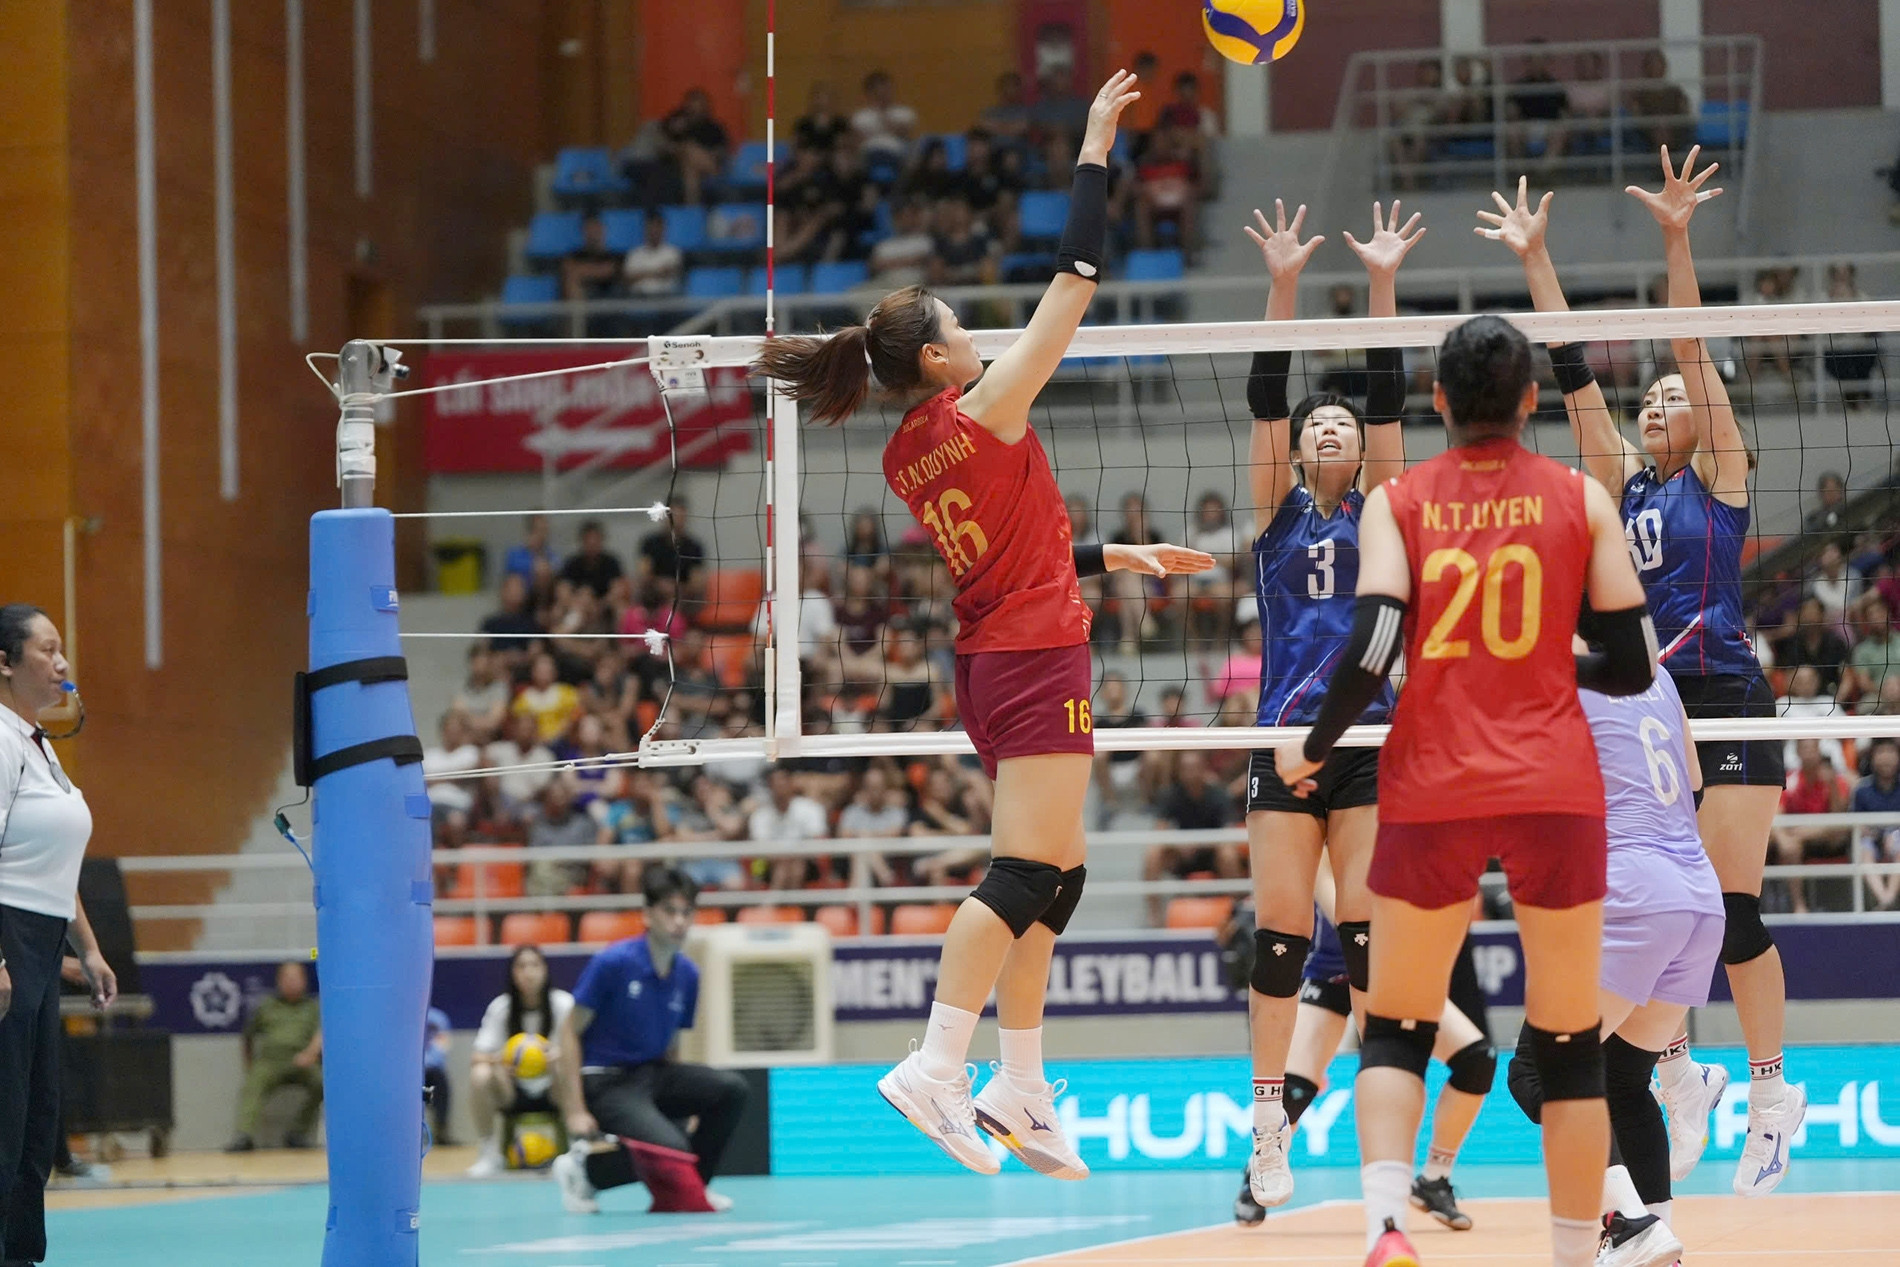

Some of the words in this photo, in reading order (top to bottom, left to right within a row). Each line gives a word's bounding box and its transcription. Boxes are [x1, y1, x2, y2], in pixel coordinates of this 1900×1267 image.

[923, 488, 989, 576] 16
[1308, 538, 1335, 600] 3
[1421, 543, 1543, 660] 20
[1064, 699, 1091, 734] 16
[1251, 776, 1259, 798] 3
[1639, 715, 1680, 806] 6
